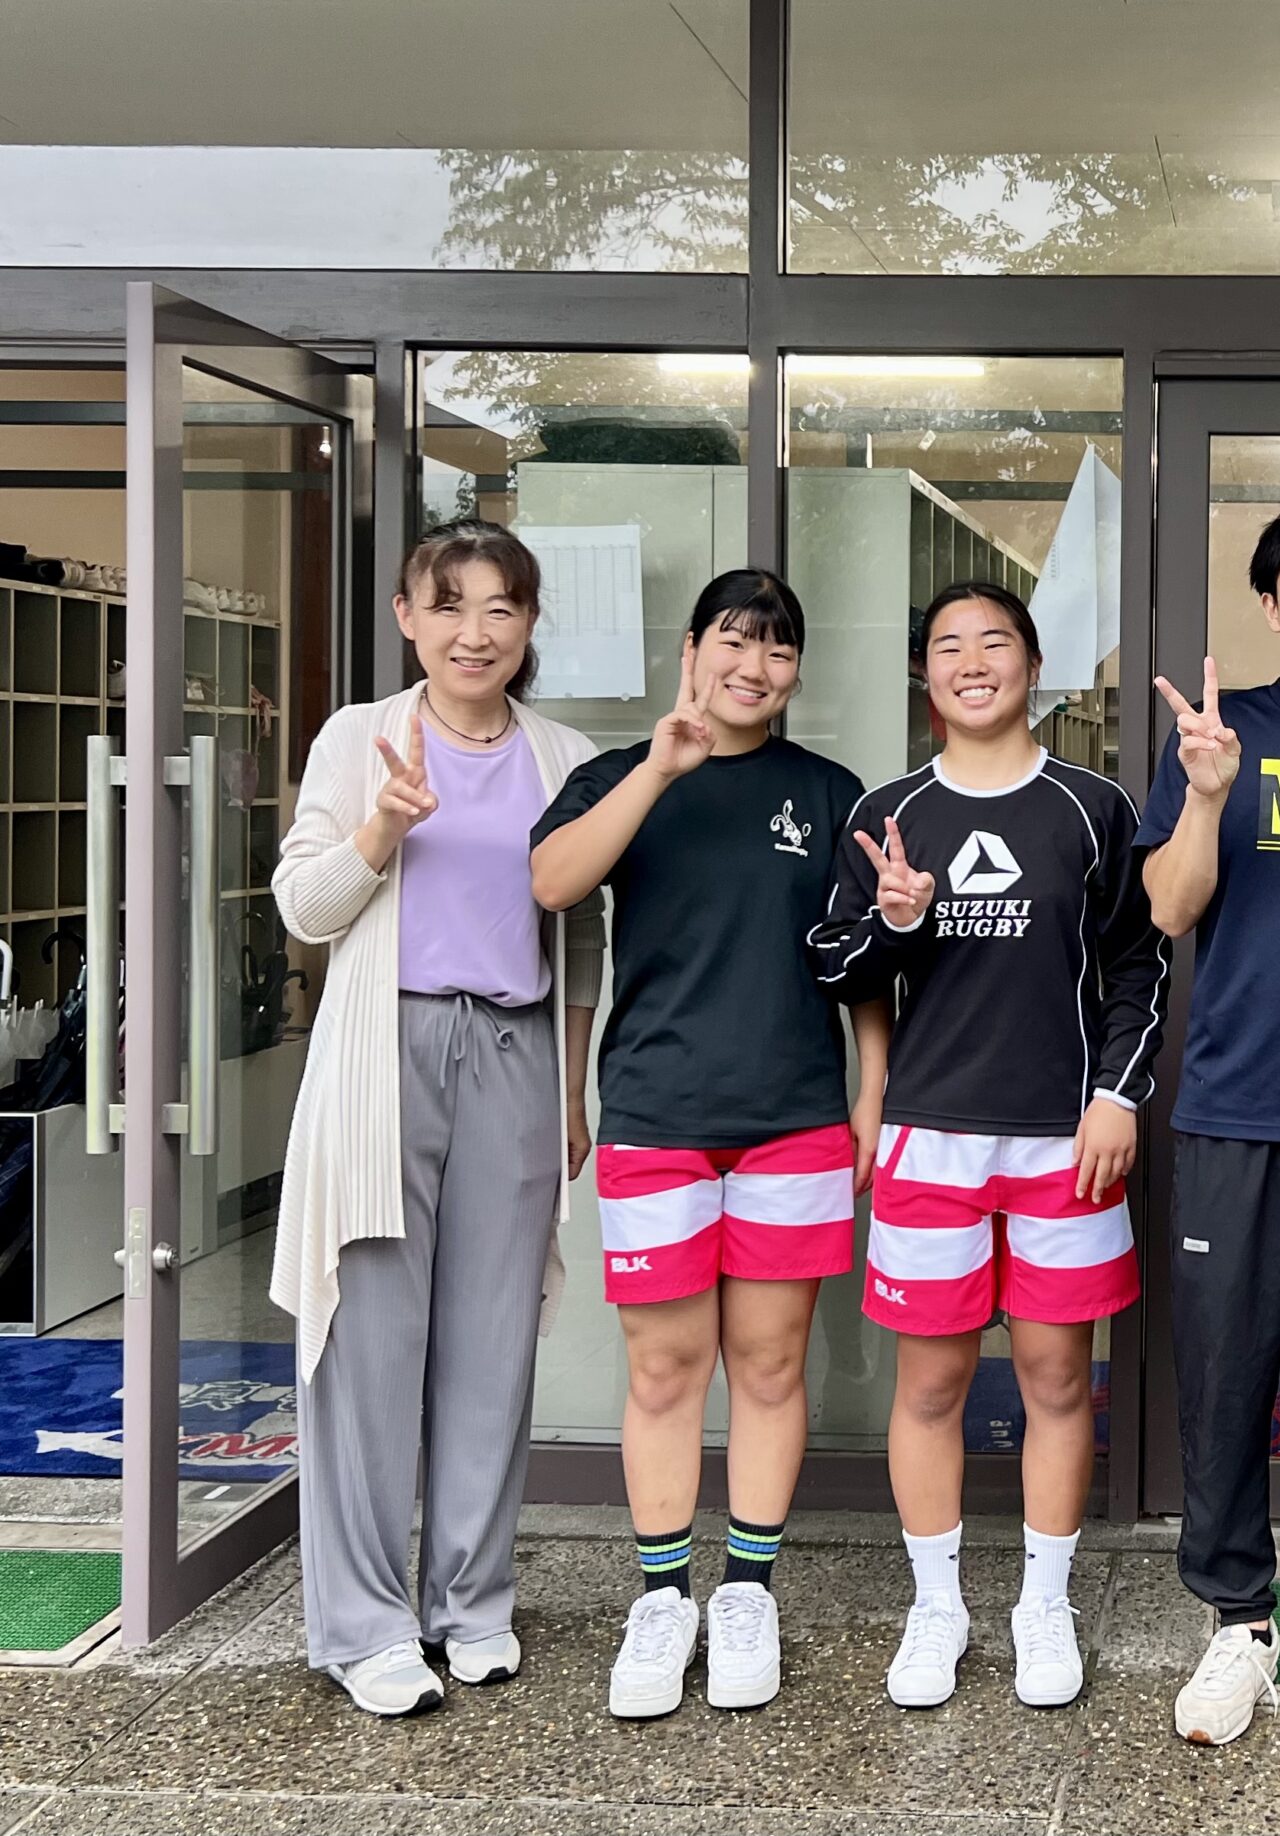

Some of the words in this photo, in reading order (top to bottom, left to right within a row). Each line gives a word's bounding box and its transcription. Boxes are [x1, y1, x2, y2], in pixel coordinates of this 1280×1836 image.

[935, 899, 1032, 919] SUZUKI
[935, 918, 1032, 937] RUGBY
[611, 1255, 653, 1273] BLK
[875, 1278, 908, 1306] BLK
